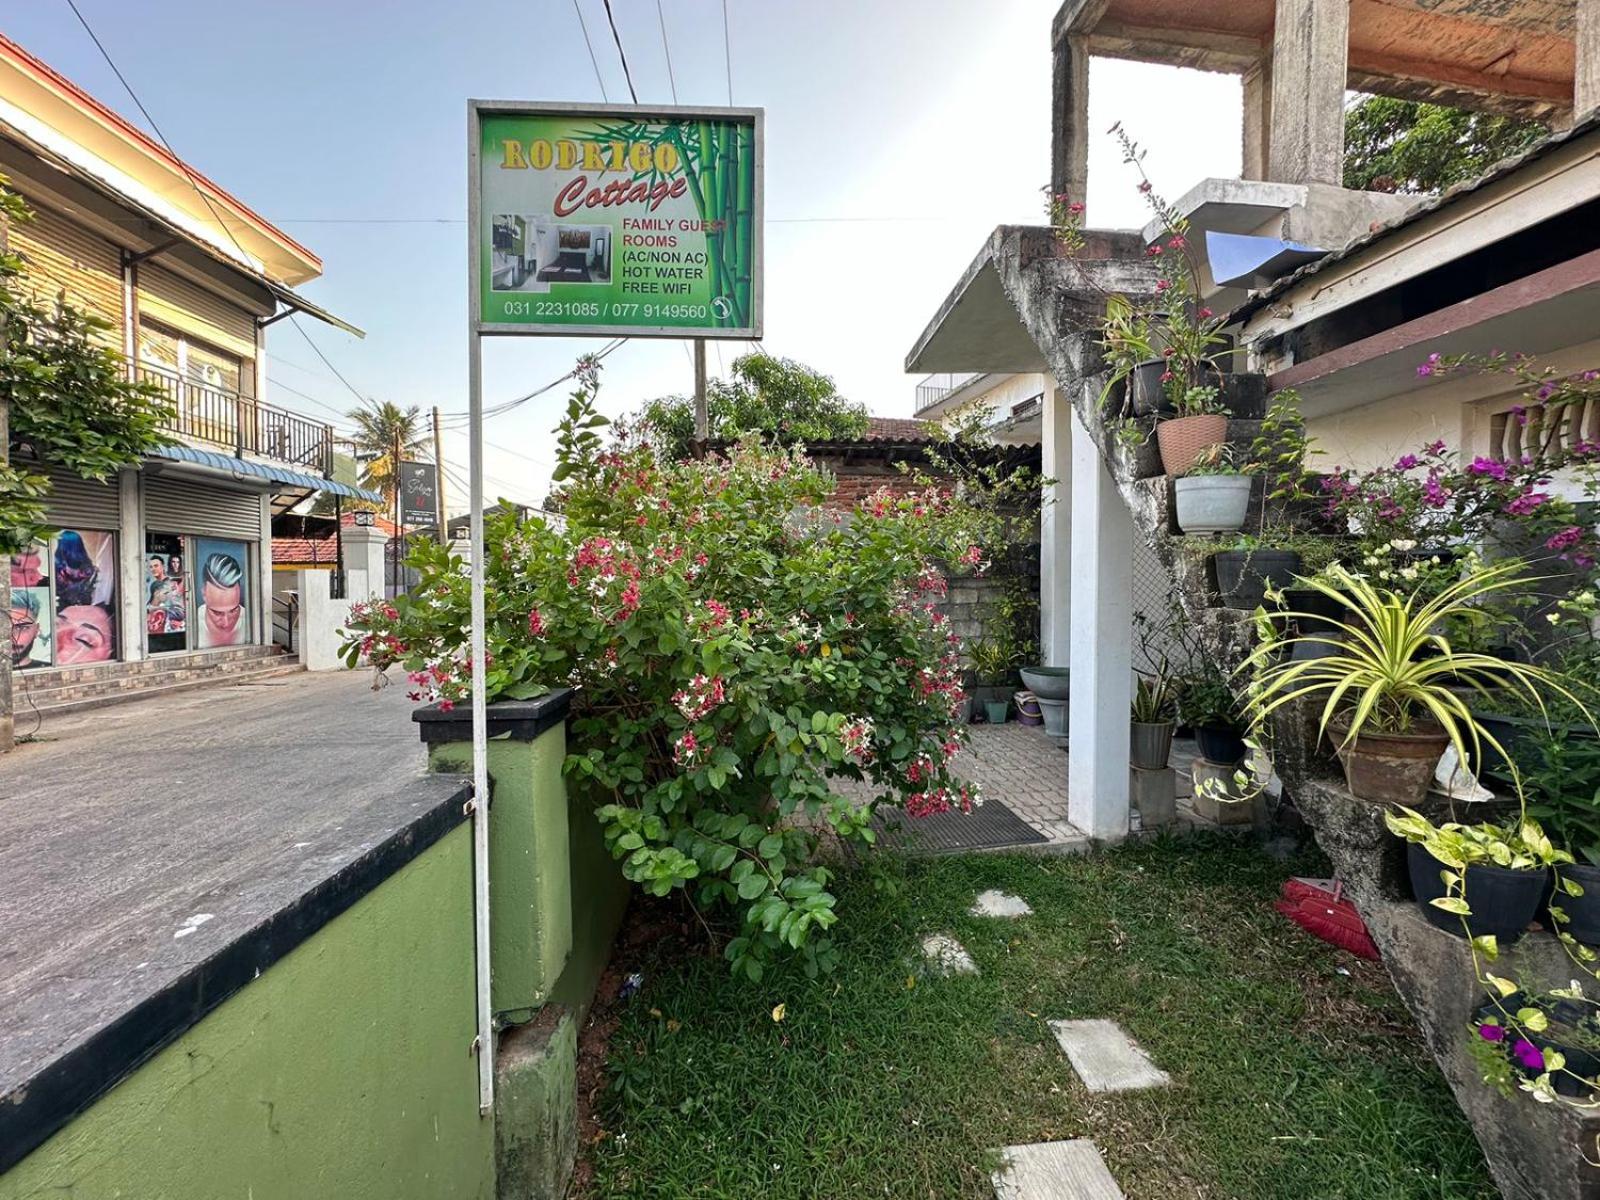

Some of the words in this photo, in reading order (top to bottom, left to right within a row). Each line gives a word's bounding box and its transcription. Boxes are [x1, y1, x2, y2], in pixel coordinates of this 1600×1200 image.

[501, 138, 679, 173] RODRIGO
[553, 174, 688, 218] Cottage
[623, 218, 674, 231] FAMILY
[623, 235, 677, 247] ROOMS
[622, 251, 680, 265] (AC/NON
[684, 252, 709, 267] AC)
[622, 267, 651, 278] HOT
[655, 267, 703, 279] WATER
[622, 282, 658, 294] FREE
[662, 283, 691, 295] WIFI
[504, 302, 530, 315] 031
[536, 302, 599, 316] 2231085
[612, 303, 638, 317] 077
[644, 304, 707, 319] 9149560
